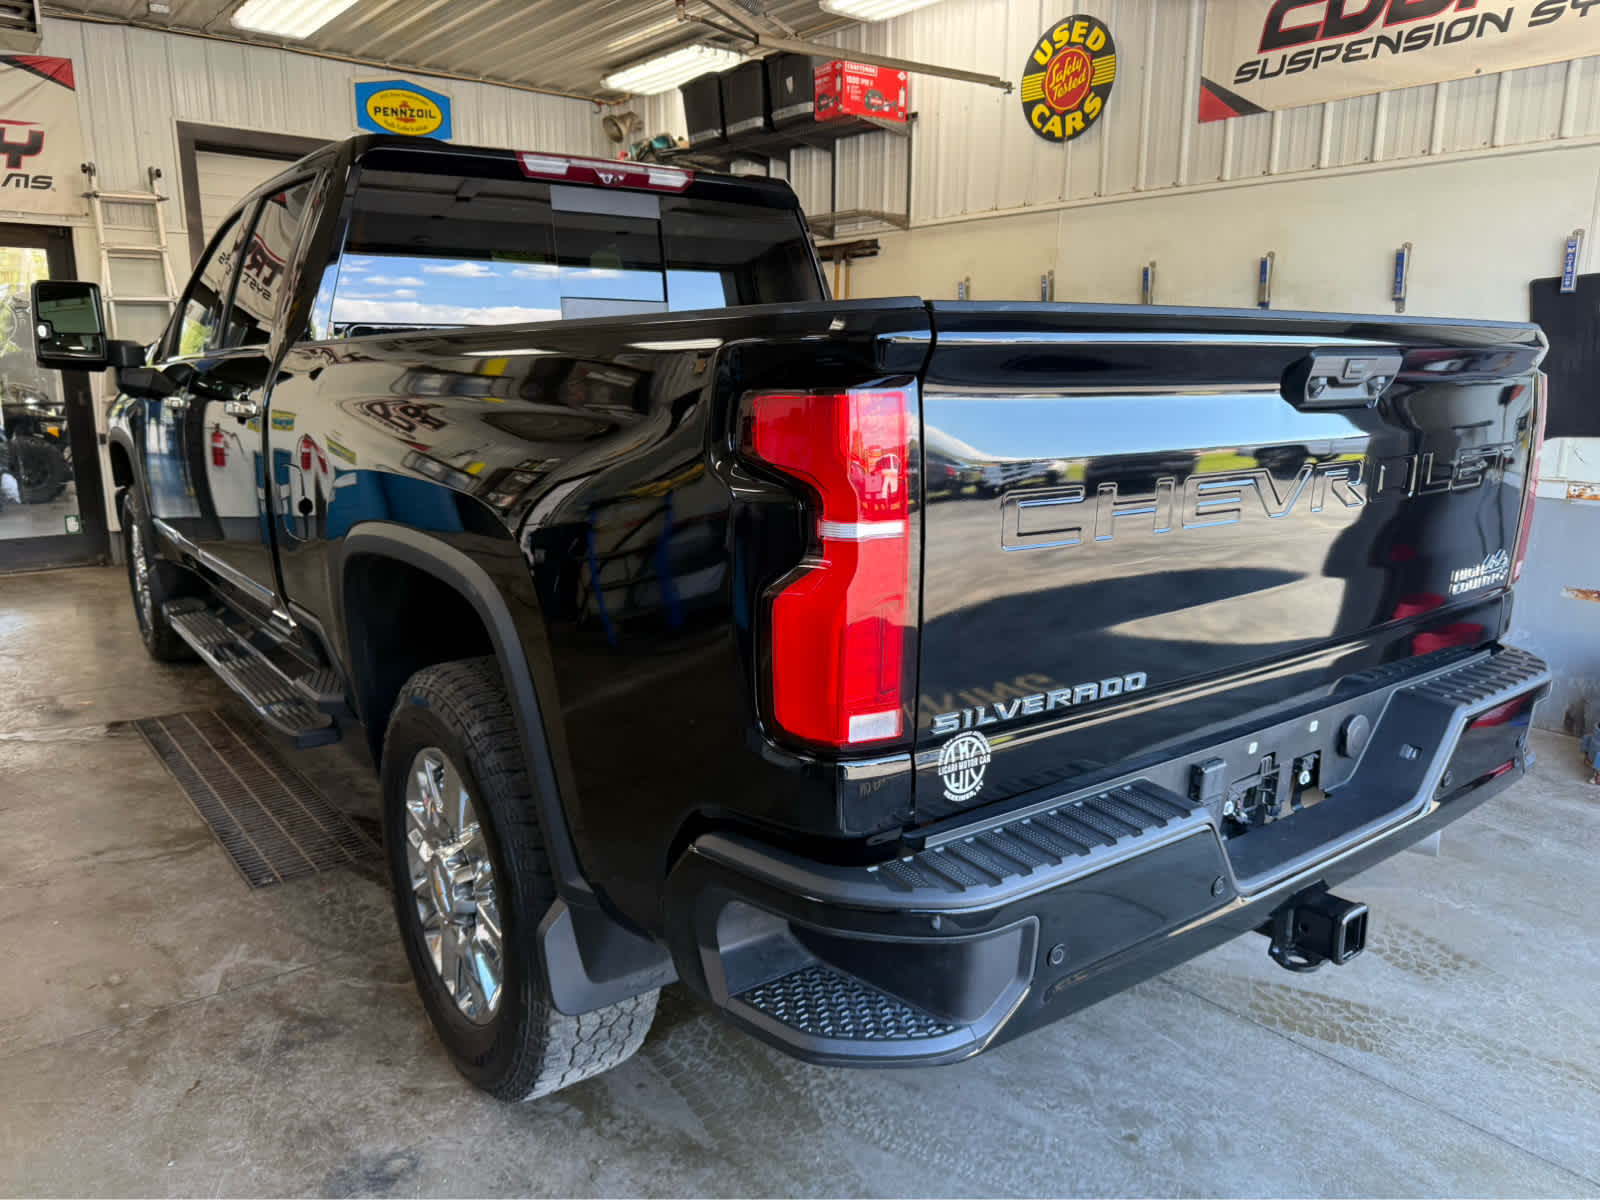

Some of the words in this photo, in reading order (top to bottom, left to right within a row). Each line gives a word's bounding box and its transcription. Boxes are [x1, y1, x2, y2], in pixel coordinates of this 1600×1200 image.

[1033, 21, 1106, 66] USED
[1233, 7, 1514, 85] SUSPENSION
[1049, 56, 1084, 88] Safety
[1052, 67, 1087, 102] Tested
[373, 106, 437, 119] PENNZOIL
[1031, 92, 1102, 138] CARS
[1000, 443, 1516, 551] CHEVROLET
[931, 671, 1147, 736] SILVERADO
[958, 757, 978, 771] MOTOR
[979, 754, 991, 765] CAR
